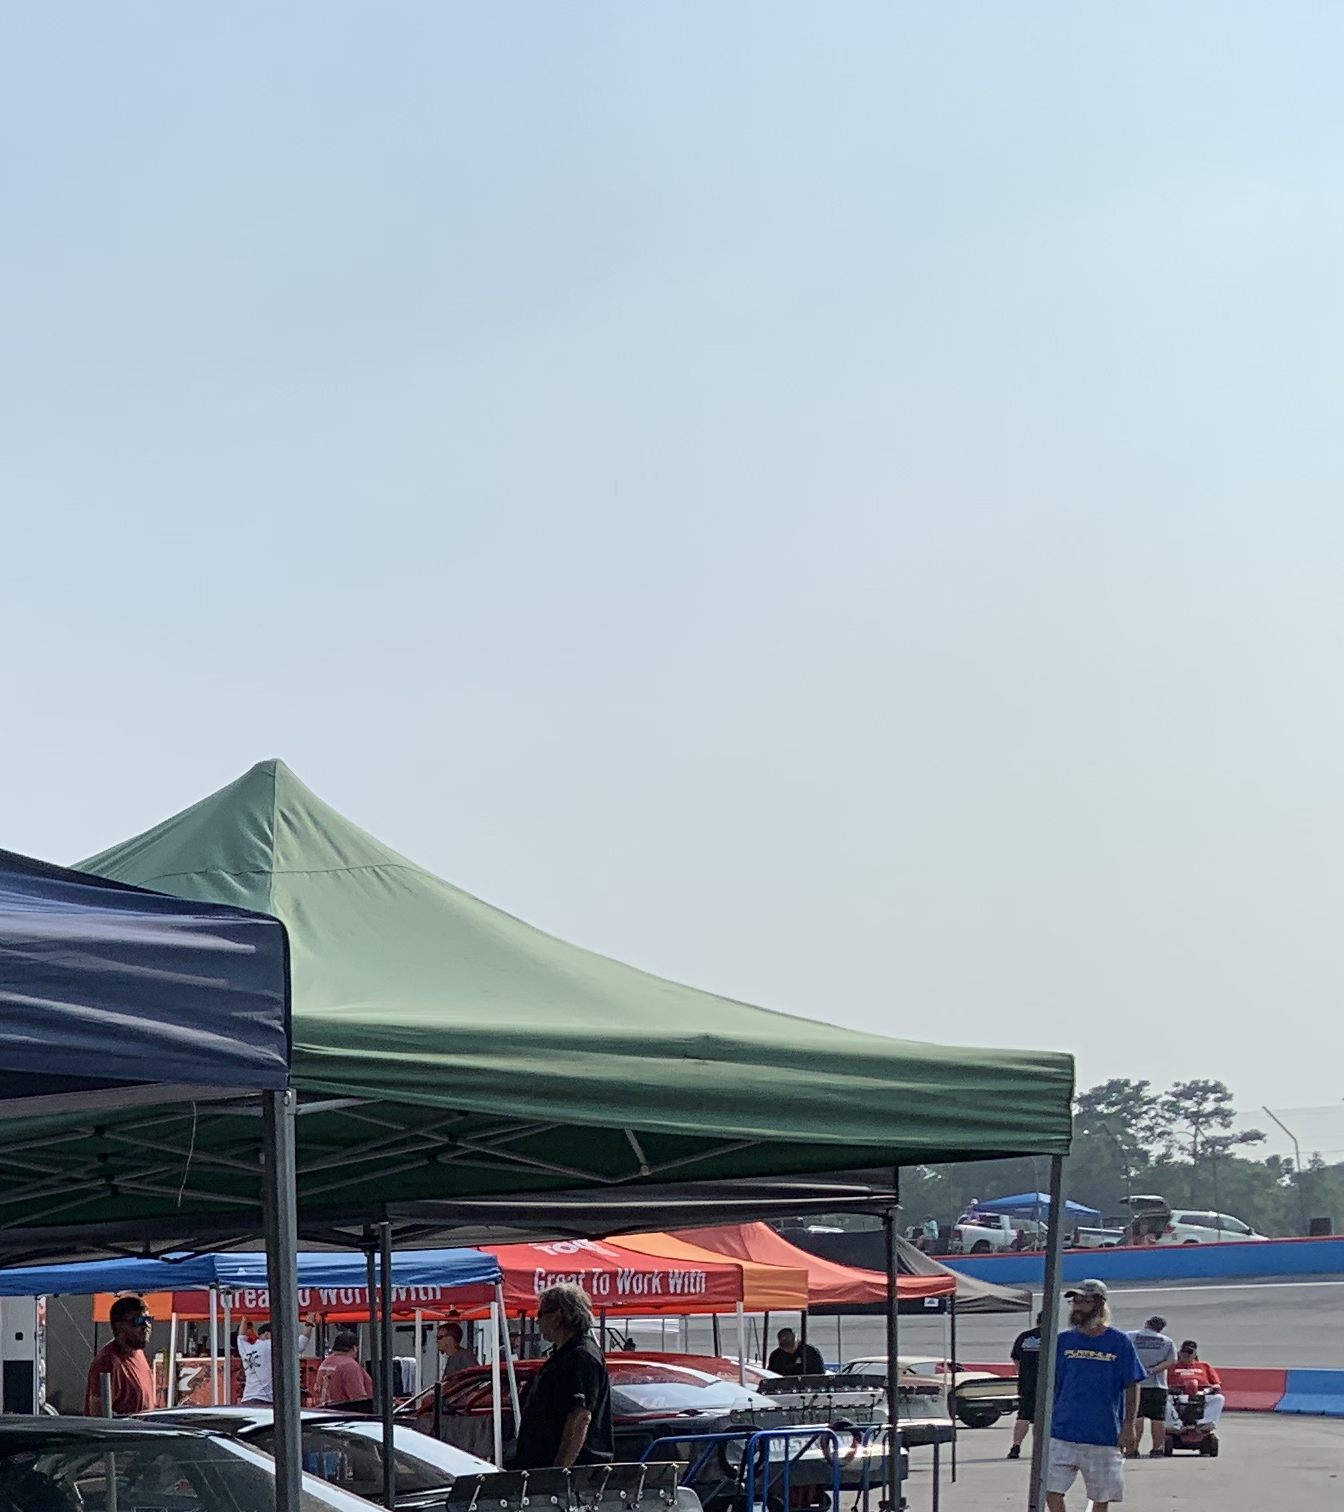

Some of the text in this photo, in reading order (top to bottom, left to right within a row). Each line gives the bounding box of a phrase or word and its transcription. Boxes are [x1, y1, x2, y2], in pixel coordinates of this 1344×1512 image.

[592, 1268, 610, 1295] To
[617, 1268, 664, 1295] Work
[668, 1268, 707, 1294] With
